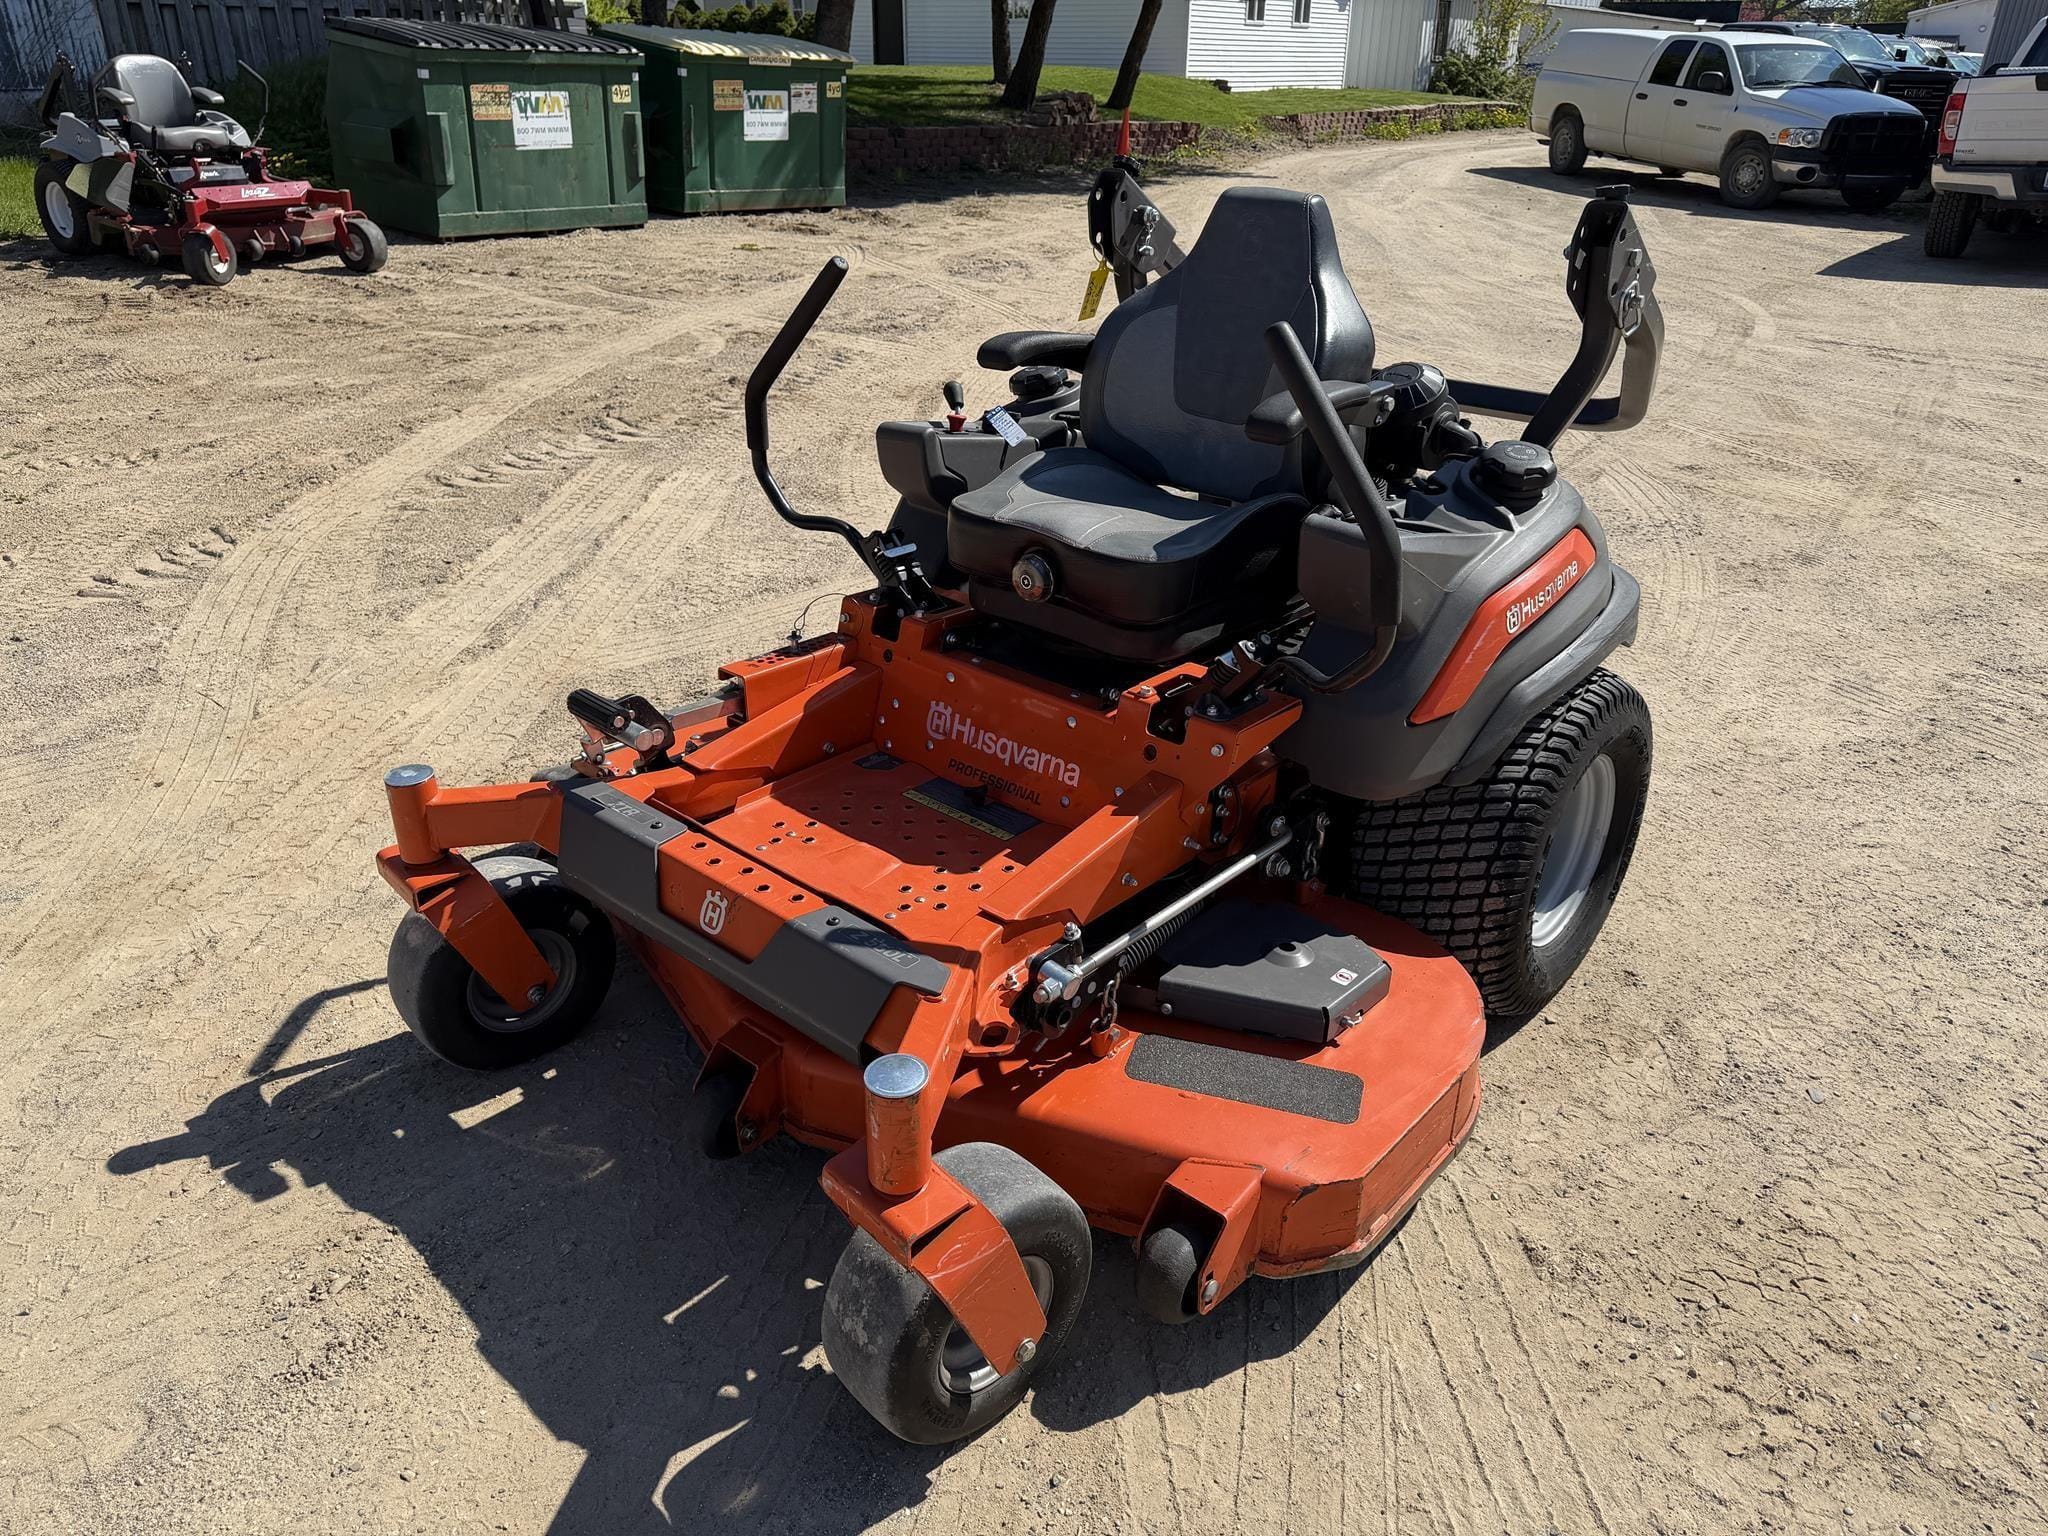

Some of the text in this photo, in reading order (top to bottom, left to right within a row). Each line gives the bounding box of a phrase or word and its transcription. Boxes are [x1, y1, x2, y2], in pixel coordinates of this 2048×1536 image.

[747, 94, 783, 110] WM
[1521, 560, 1578, 622] Husqvarna
[951, 713, 1081, 787] Husqvarna
[947, 757, 1042, 806] PROFESSIONAL
